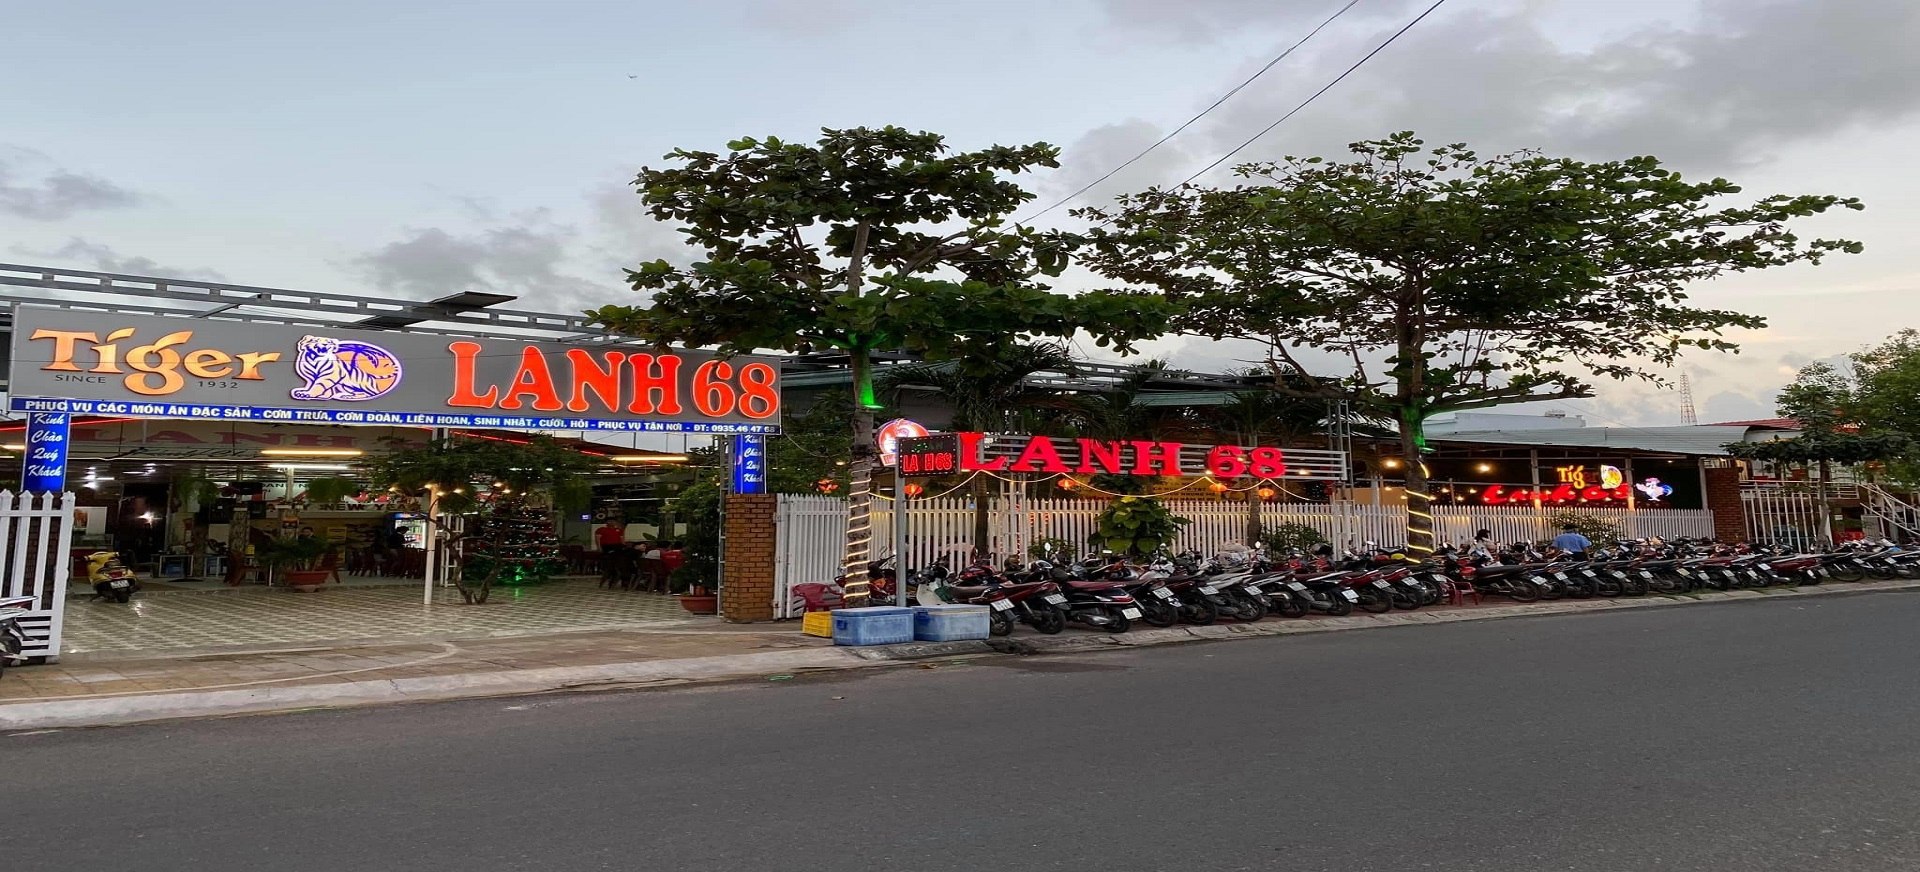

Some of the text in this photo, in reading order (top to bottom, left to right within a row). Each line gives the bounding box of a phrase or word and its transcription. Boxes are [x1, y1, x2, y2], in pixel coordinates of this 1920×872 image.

[29, 327, 281, 396] Tiger
[55, 374, 106, 384] SINCE
[198, 380, 239, 389] 1932
[447, 341, 780, 419] LANH 68
[34, 413, 65, 425] Kính
[72, 402, 92, 413] VỤ
[97, 402, 126, 413] CÁC
[131, 403, 164, 414] MÓN
[191, 406, 220, 417] ĐẶC
[224, 406, 251, 418] SẢN
[263, 409, 292, 419] CƠM
[336, 411, 363, 421] CƠM
[406, 414, 434, 424] LIÊN
[474, 417, 500, 426] SINH
[598, 421, 626, 430] PHỤC
[628, 422, 641, 431] VỤ
[31, 429, 63, 443] Chào
[32, 447, 59, 462] Quý
[958, 432, 1288, 479] LANH 68
[28, 464, 62, 477] Khách
